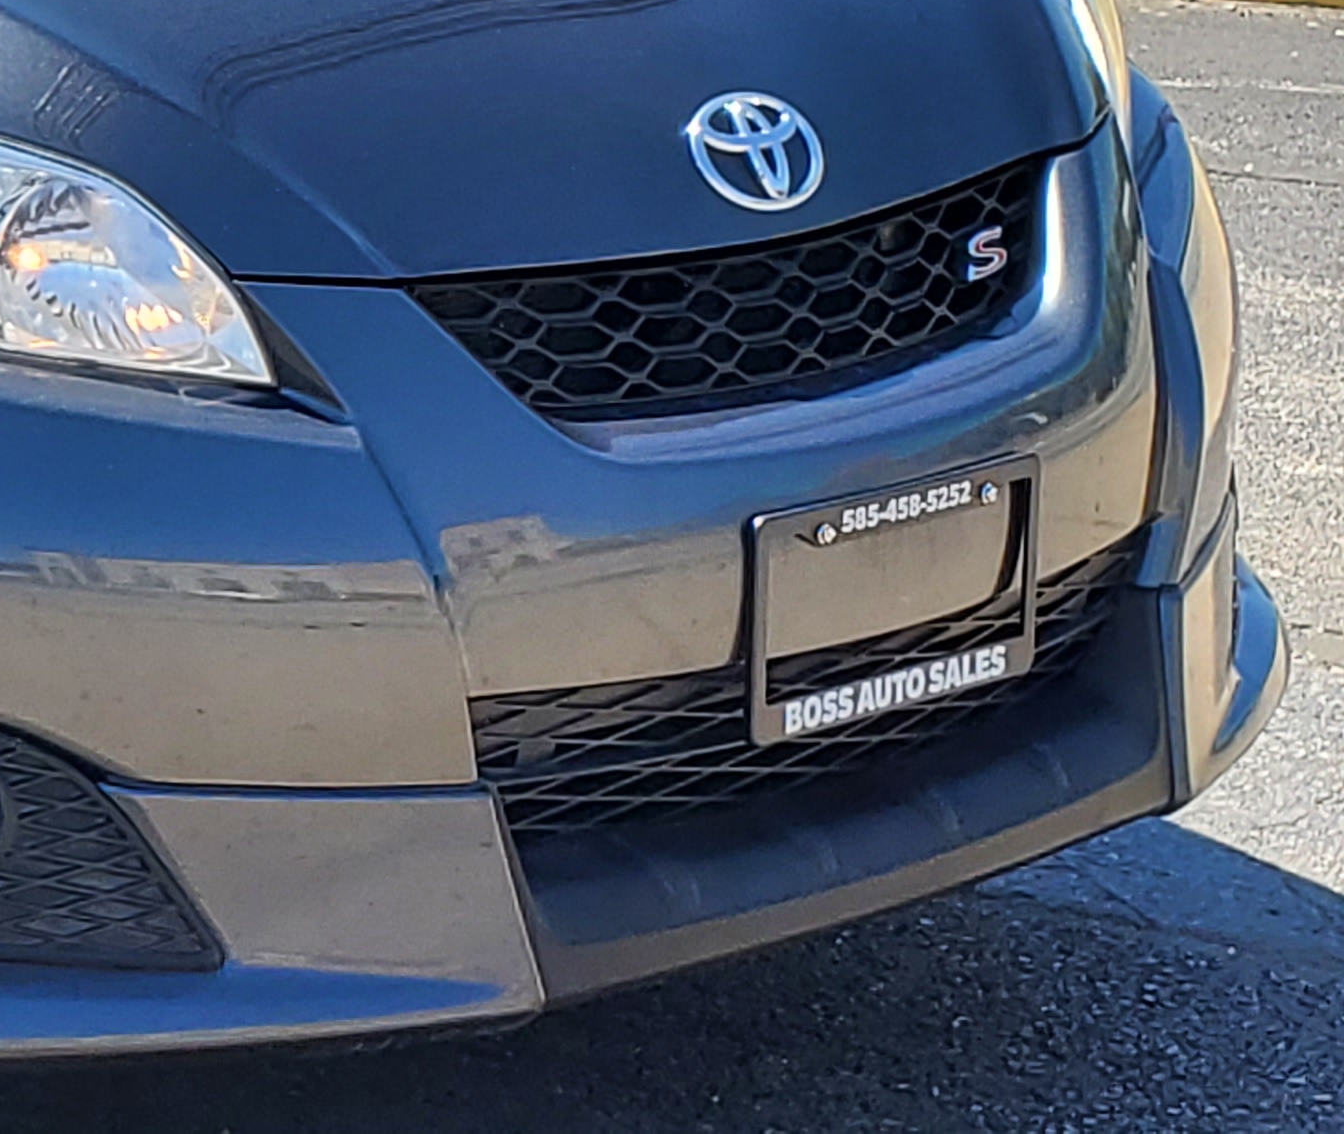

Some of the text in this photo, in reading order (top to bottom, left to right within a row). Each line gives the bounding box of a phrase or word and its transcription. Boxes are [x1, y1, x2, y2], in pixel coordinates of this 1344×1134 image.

[967, 225, 1008, 282] S
[840, 479, 973, 535] 585-458-5252
[784, 644, 1008, 735] BOSS AUTO SALES
